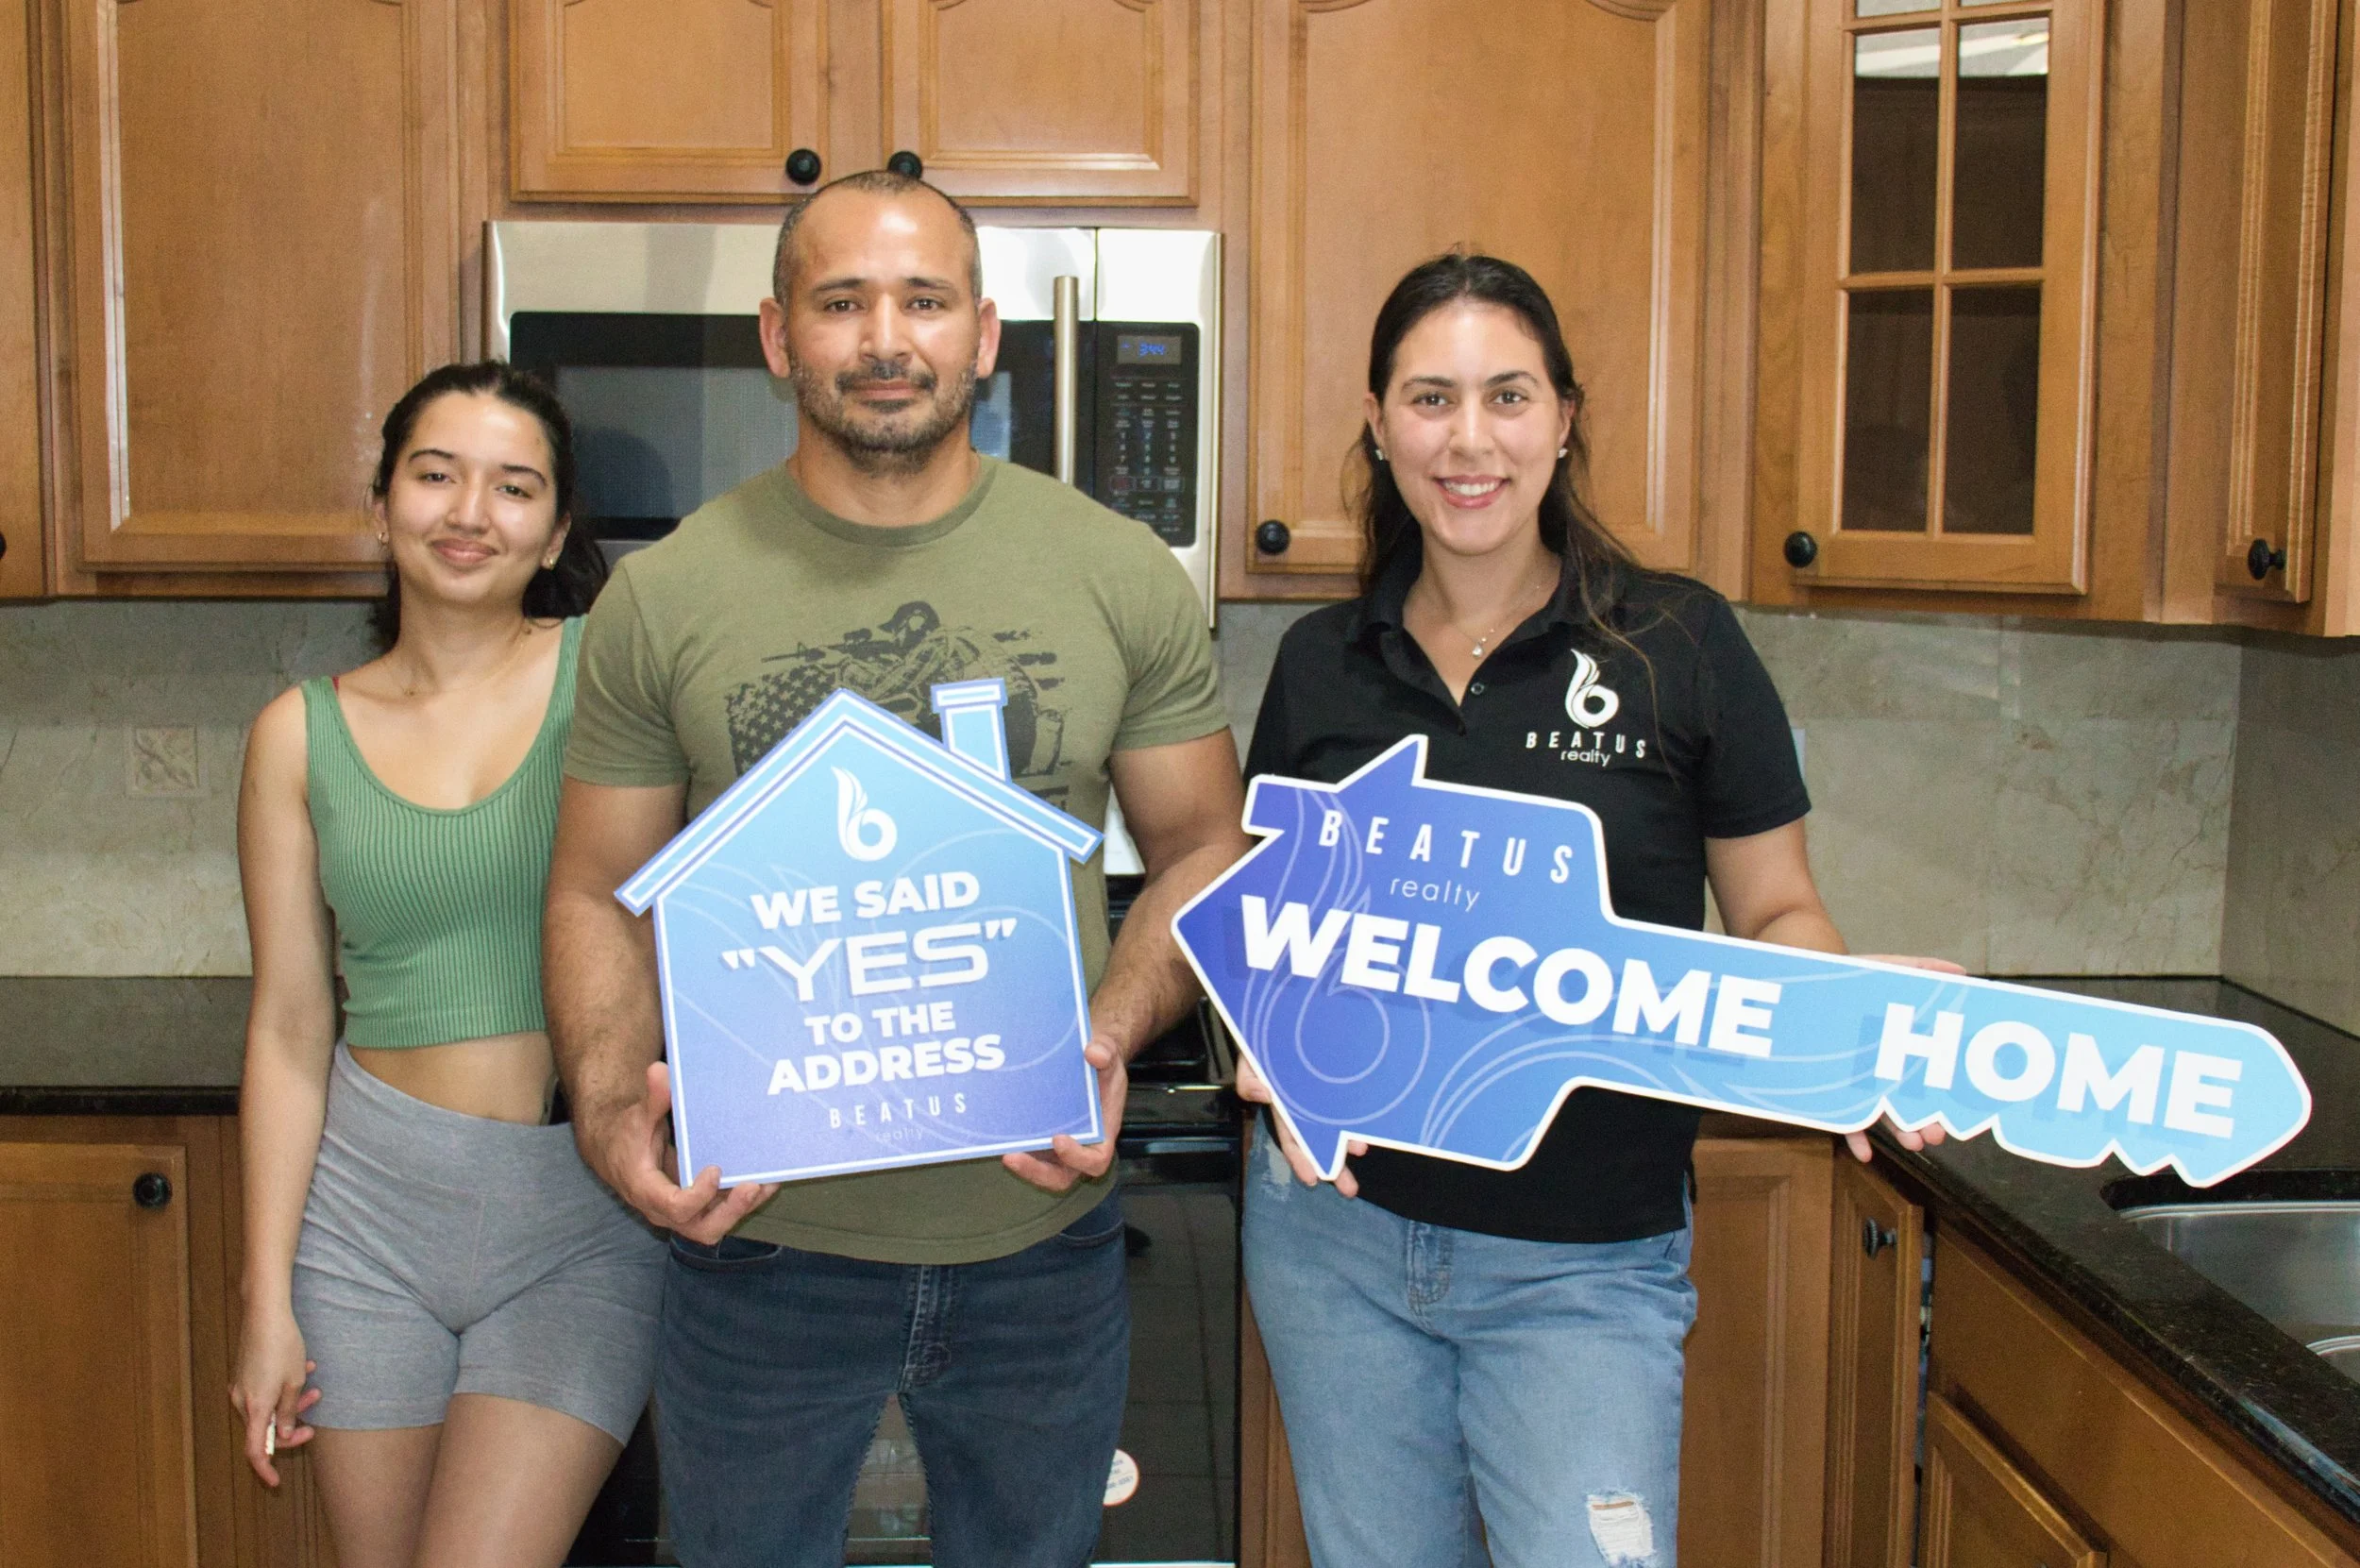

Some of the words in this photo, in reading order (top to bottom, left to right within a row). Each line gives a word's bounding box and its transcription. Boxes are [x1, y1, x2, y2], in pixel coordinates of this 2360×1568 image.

[1526, 731, 1646, 759] BEATUS
[1560, 749, 1610, 767] realty
[1319, 809, 1574, 884] BEATUS
[750, 885, 843, 930] WE
[853, 870, 981, 919] SAID
[1389, 877, 1481, 914] realty
[803, 1012, 864, 1047] TO
[870, 1001, 956, 1039] THE
[1241, 894, 1782, 1058] WELCOME
[1874, 1003, 2243, 1139] HOME
[767, 1035, 1006, 1096] ADDRESS
[829, 1092, 967, 1129] BEATUS
